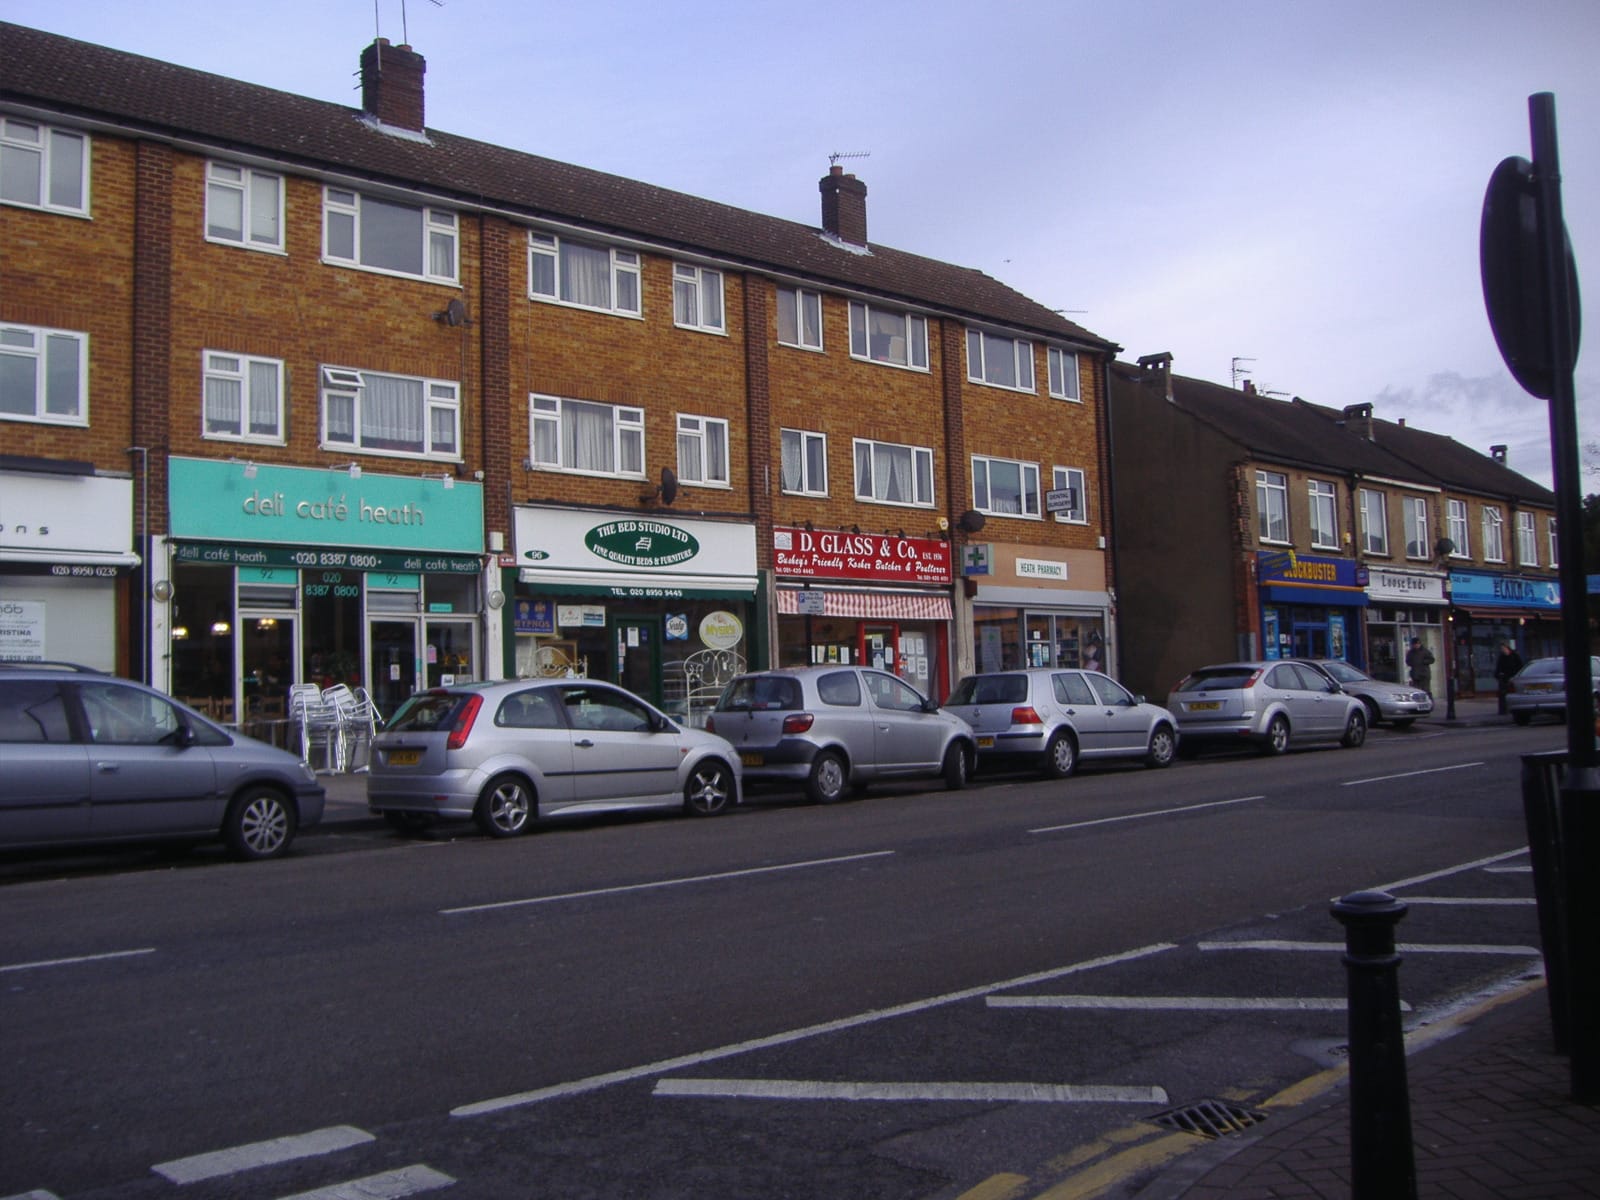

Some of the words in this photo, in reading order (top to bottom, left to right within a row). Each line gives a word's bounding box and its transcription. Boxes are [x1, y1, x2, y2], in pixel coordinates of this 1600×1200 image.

[243, 490, 285, 516] deli
[296, 494, 348, 521] café
[359, 497, 425, 526] heath
[597, 523, 617, 538] THE
[617, 521, 637, 533] BED
[638, 521, 671, 536] STUDIO
[671, 528, 689, 543] LTD
[800, 533, 816, 552] D.
[820, 534, 874, 556] GLASS
[880, 539, 891, 557] &
[897, 540, 918, 559] Co.
[179, 547, 199, 558] deli
[204, 549, 230, 560] café
[235, 550, 267, 562] heath
[296, 552, 317, 565] 020
[320, 553, 347, 566] 8387
[350, 555, 376, 567] 0800
[404, 558, 421, 569] deli
[425, 559, 448, 570] café
[451, 560, 479, 572] heath
[531, 551, 543, 560] 96
[593, 543, 609, 557] FINE
[608, 550, 635, 565] QUALITY
[636, 556, 653, 566] BEDS
[654, 557, 661, 566] &
[660, 548, 694, 565] FURNITURE
[812, 554, 844, 570] Friendly
[847, 556, 871, 570] Kosher
[875, 559, 902, 572] Butcher
[905, 561, 912, 572] &
[915, 561, 946, 574] Poulterer
[1020, 562, 1036, 574] HEATH
[1037, 564, 1062, 576] PHARMACY
[52, 566, 70, 575] 020
[72, 566, 94, 576] 8950
[96, 567, 117, 577] 0235
[261, 569, 273, 579] 92
[322, 571, 342, 583] 020
[386, 575, 398, 585] 92
[1381, 574, 1406, 589] Loose
[1407, 576, 1427, 591] Ends
[305, 584, 330, 596] 8387
[334, 585, 359, 597] 0800
[610, 587, 628, 596] TEL.
[629, 588, 645, 596] 020
[646, 588, 663, 597] 8950
